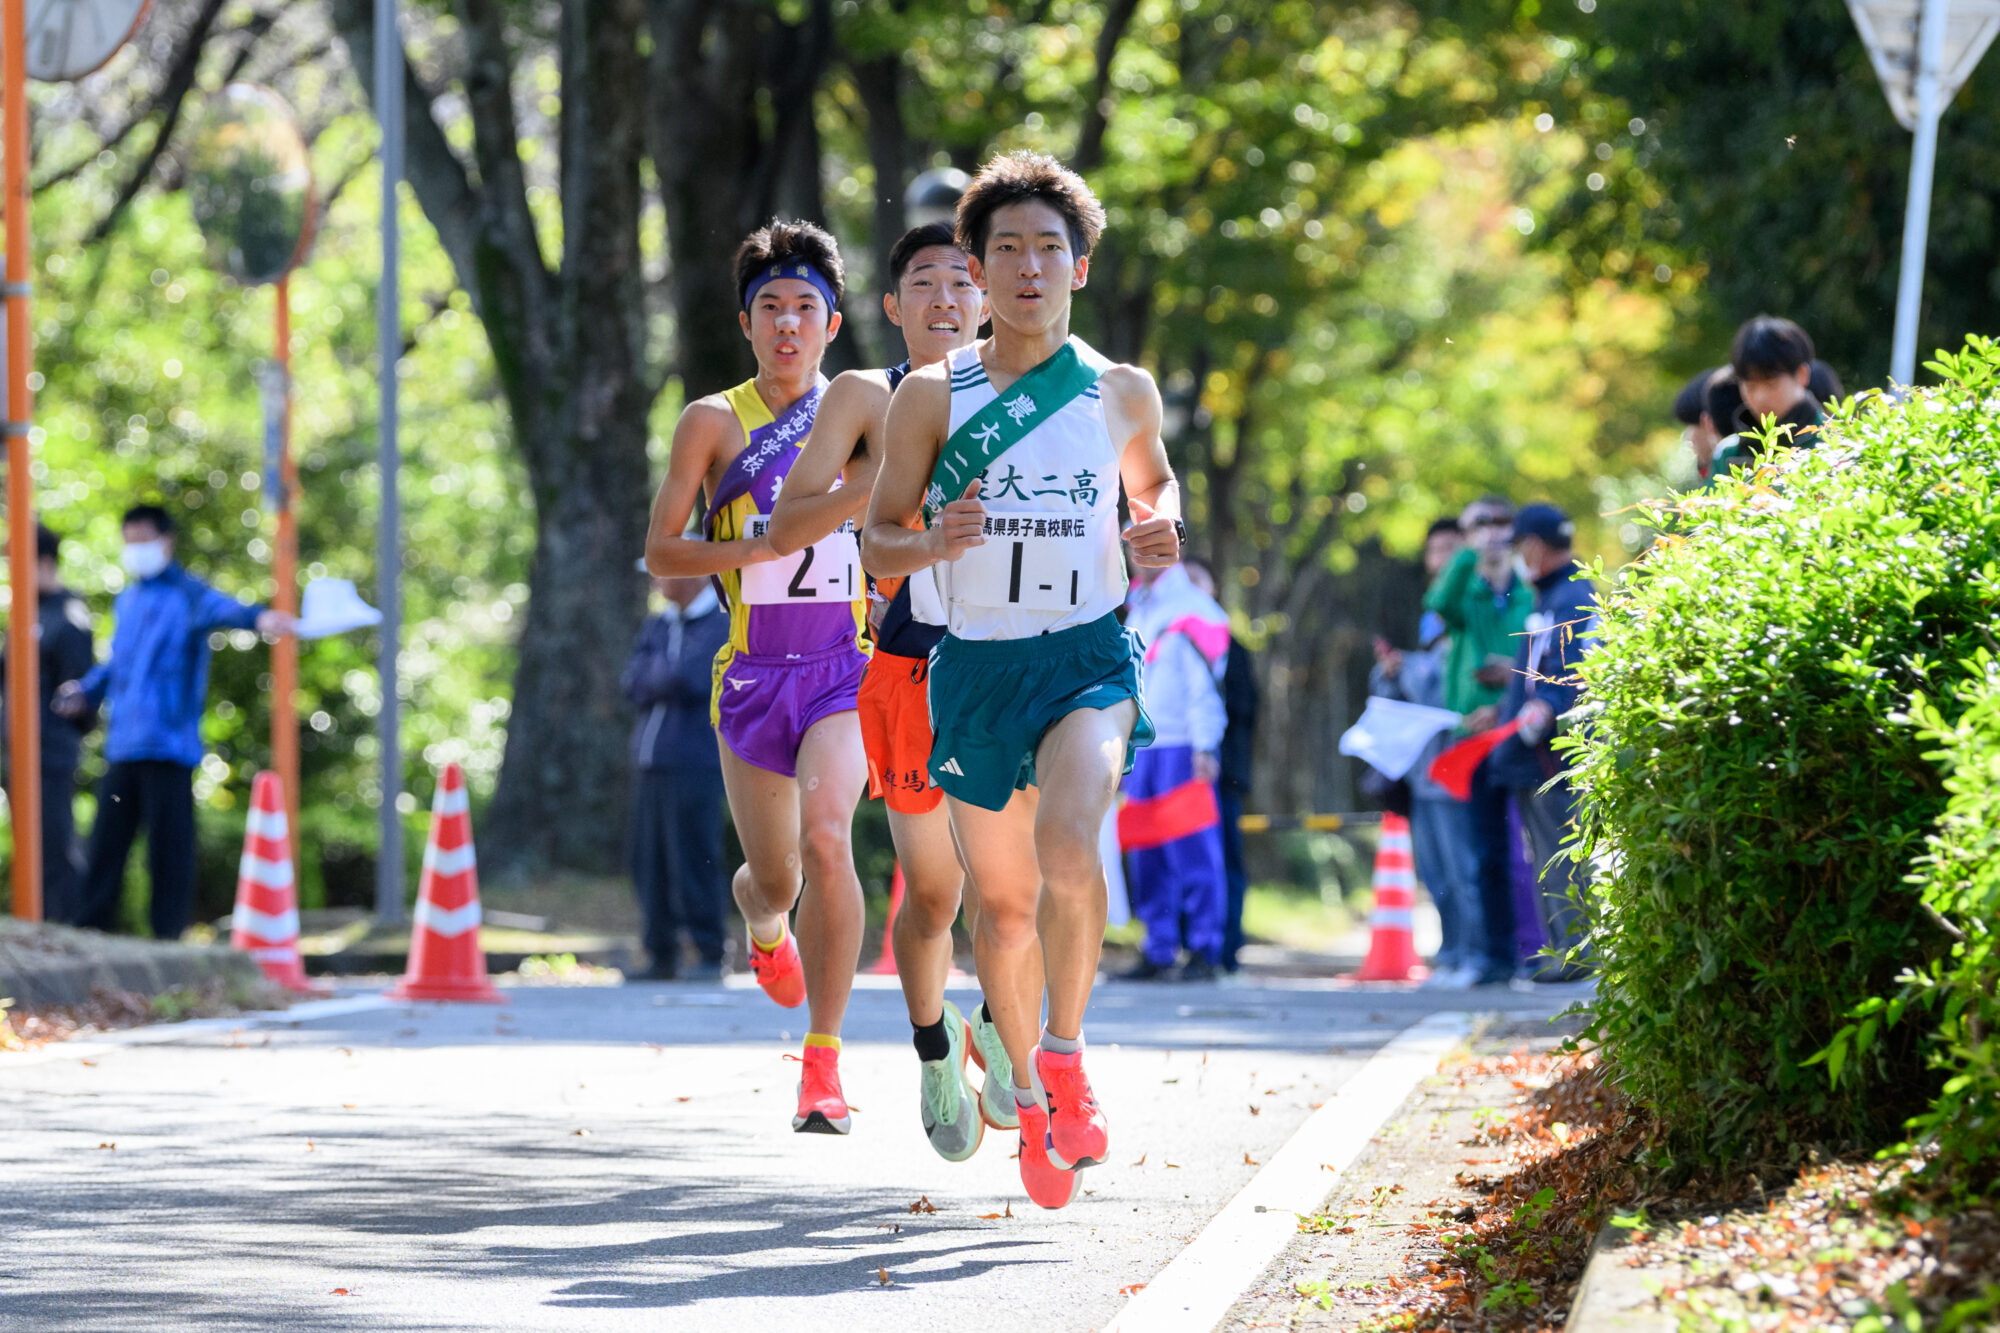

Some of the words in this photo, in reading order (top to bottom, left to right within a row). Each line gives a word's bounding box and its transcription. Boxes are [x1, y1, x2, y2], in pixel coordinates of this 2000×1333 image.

[926, 393, 1037, 514] 農大二高
[982, 516, 1086, 539] 馬県男子高校駅伝
[787, 545, 852, 598] 2-1
[1008, 541, 1079, 606] 1-1
